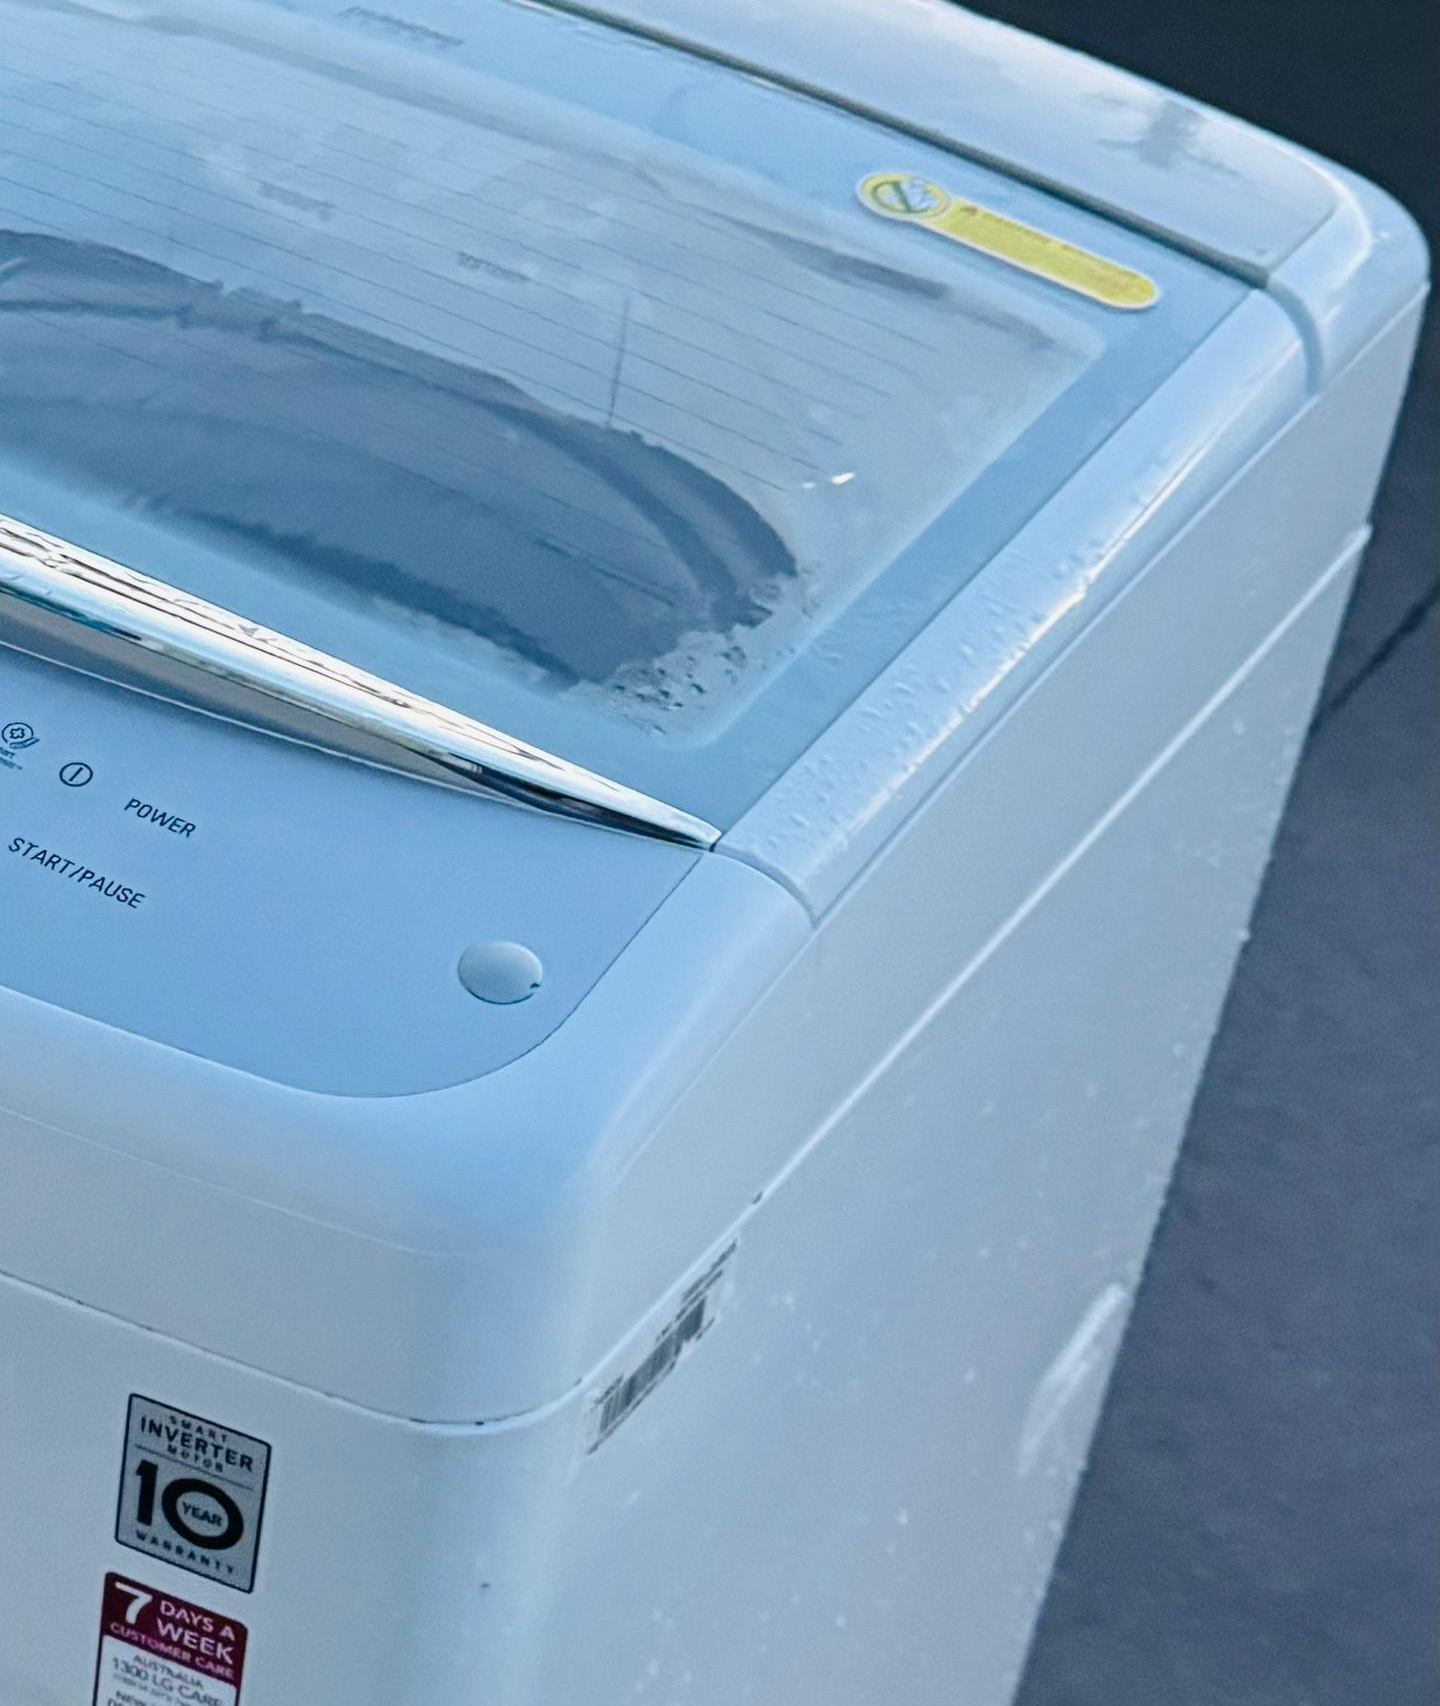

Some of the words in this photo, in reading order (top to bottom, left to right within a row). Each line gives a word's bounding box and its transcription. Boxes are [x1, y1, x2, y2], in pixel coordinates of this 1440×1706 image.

[124, 797, 197, 838] POWER
[8, 837, 147, 909] START/PAUSE
[140, 1414, 254, 1473] INVERTER
[169, 1415, 227, 1443] SMART
[167, 1444, 224, 1474] MOTOR
[135, 1459, 244, 1551] 10
[182, 1501, 224, 1528] YEAR
[135, 1529, 235, 1575] WARRANTY
[114, 1581, 153, 1625] 7
[160, 1600, 214, 1633] DAYS
[220, 1626, 235, 1642] A
[110, 1622, 192, 1662] CUSTOMER
[195, 1656, 235, 1680] CARE
[156, 1617, 234, 1665] WEEK
[113, 1658, 148, 1682] 1300
[152, 1675, 174, 1692] LG
[133, 1654, 205, 1690] AUSTRALIA
